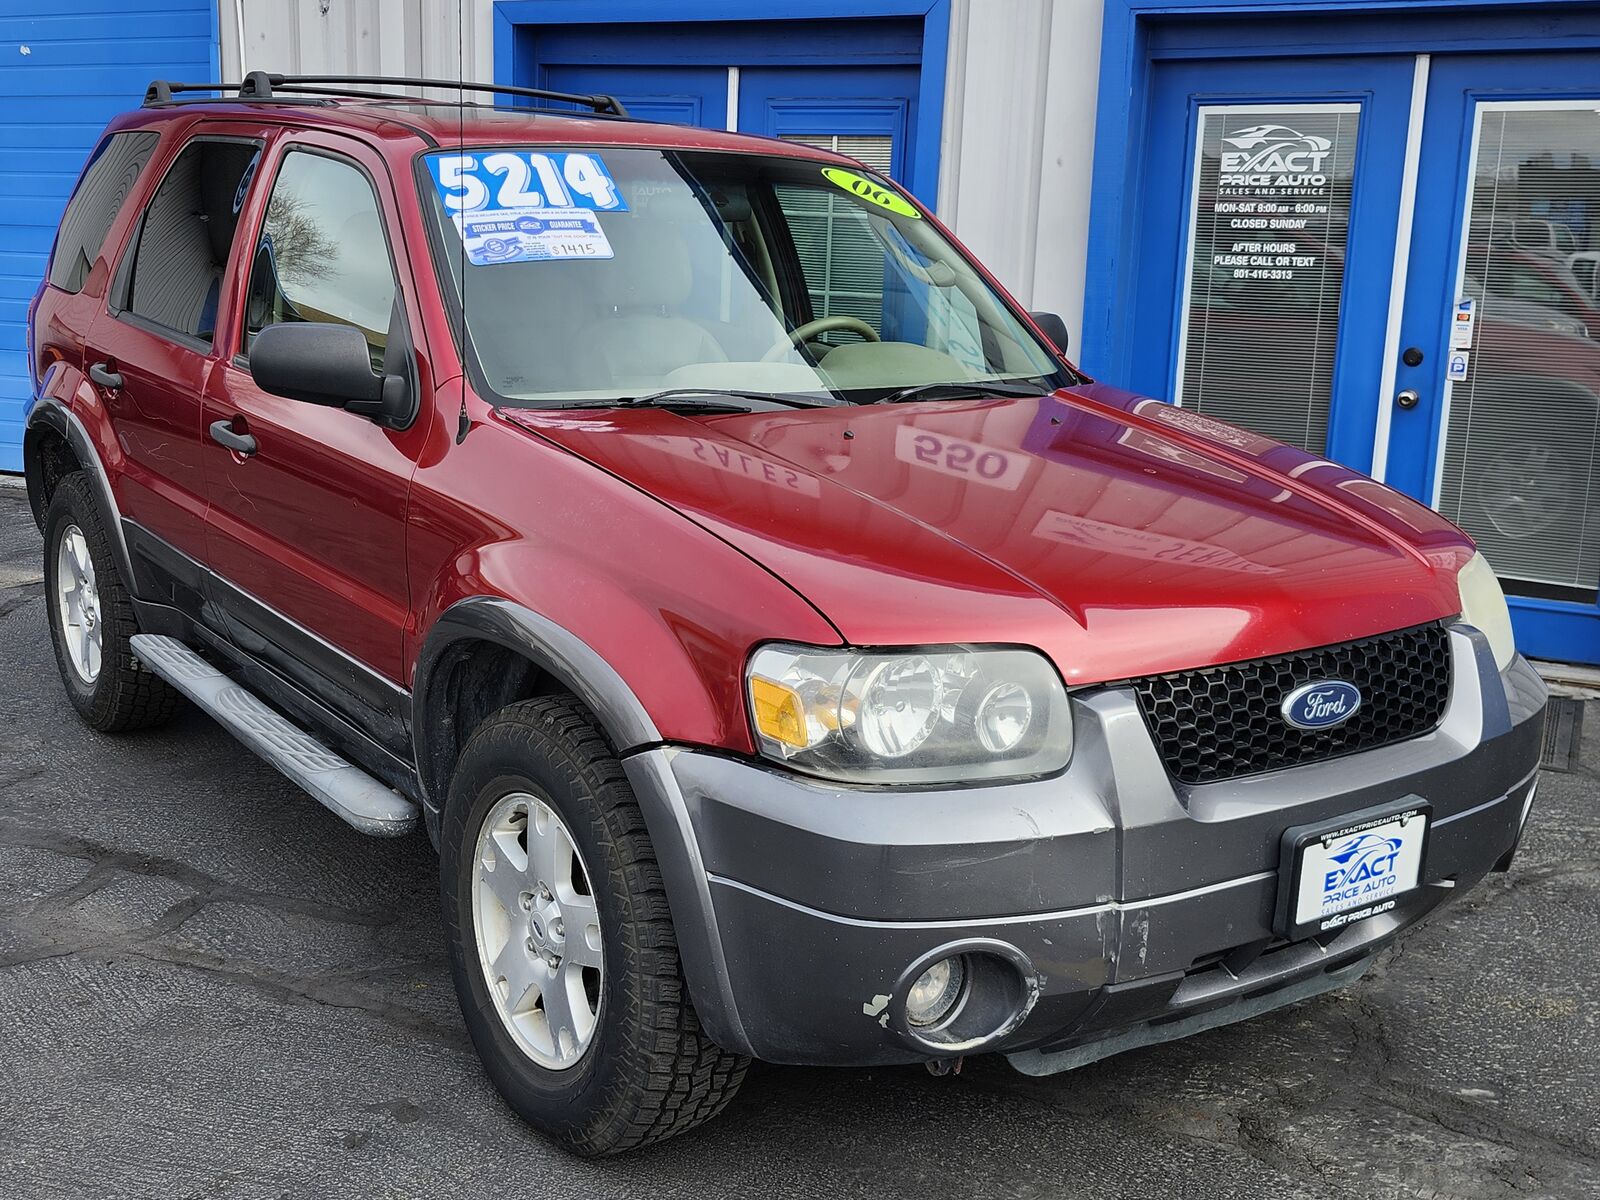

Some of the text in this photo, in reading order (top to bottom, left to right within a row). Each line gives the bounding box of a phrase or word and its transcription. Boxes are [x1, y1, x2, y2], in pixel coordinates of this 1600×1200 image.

[1220, 150, 1329, 173] EXACT
[438, 153, 615, 210] 5214
[852, 180, 890, 205] 06
[1220, 174, 1326, 186] PRICE AUTO
[1214, 203, 1257, 213] MON-SAT
[1295, 203, 1315, 213] 6:00
[472, 223, 497, 233] STICKER
[497, 222, 515, 231] PRICE
[549, 220, 583, 229] GUARANTEE
[1230, 219, 1307, 229] CLOSED SUNDAY
[1232, 243, 1296, 253] AFTER HOURS
[1214, 255, 1316, 267] PLEASE CALL OR TEXT
[1304, 689, 1346, 720] Ford
[1320, 809, 1418, 841] WWW.EXACTPRICEAUTO.COM
[1323, 850, 1400, 893] EXACT
[1321, 887, 1395, 916] SALES AND SERVICE
[1322, 874, 1397, 906] PRICE AUTO
[1320, 900, 1396, 931] EXACT PRICE AUTO
